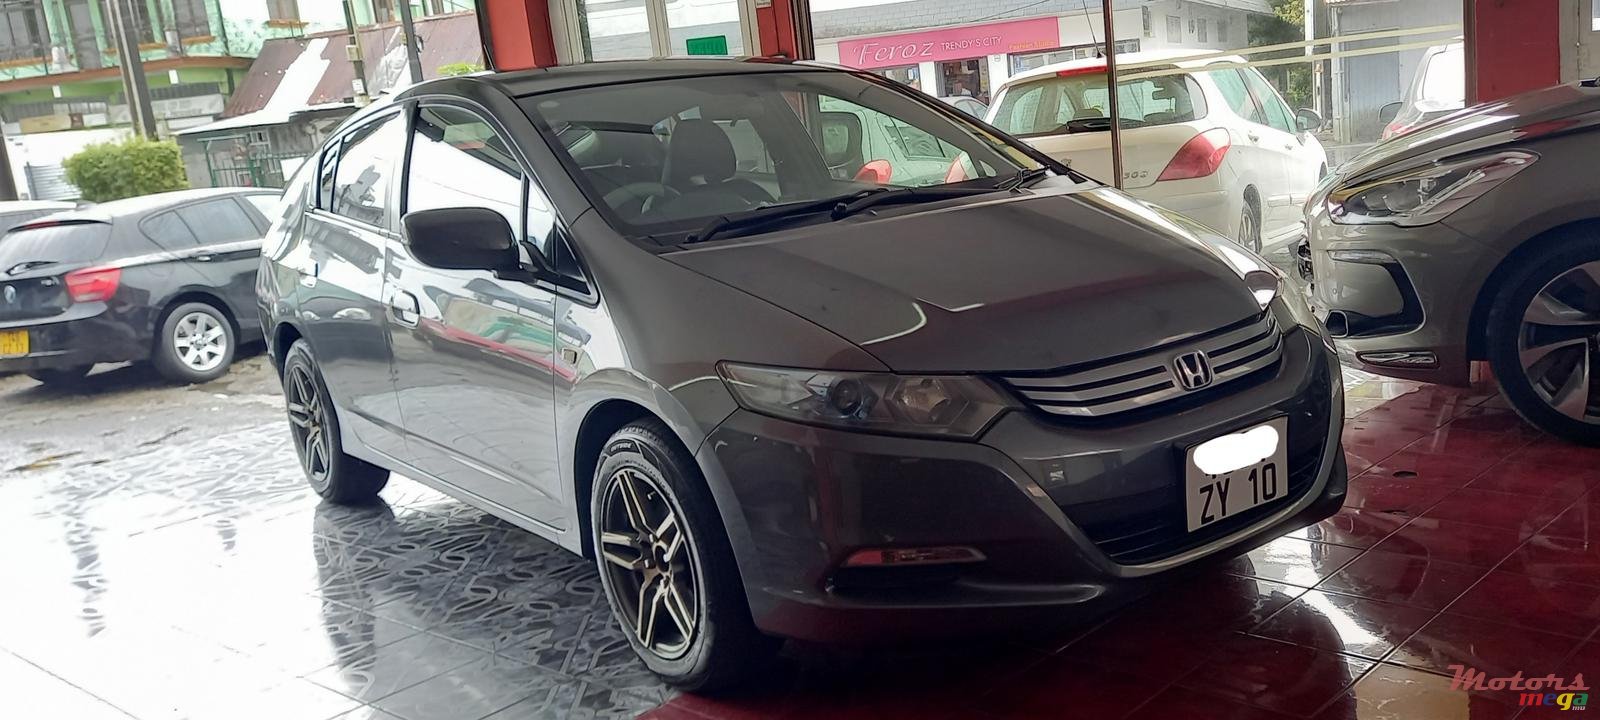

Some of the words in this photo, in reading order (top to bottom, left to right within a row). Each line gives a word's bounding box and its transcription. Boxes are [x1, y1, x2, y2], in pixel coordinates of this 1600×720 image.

[941, 38, 980, 51] TRENDY'S
[983, 36, 1002, 47] CITY
[1199, 477, 1231, 525] ZY
[1248, 463, 1277, 505] 10
